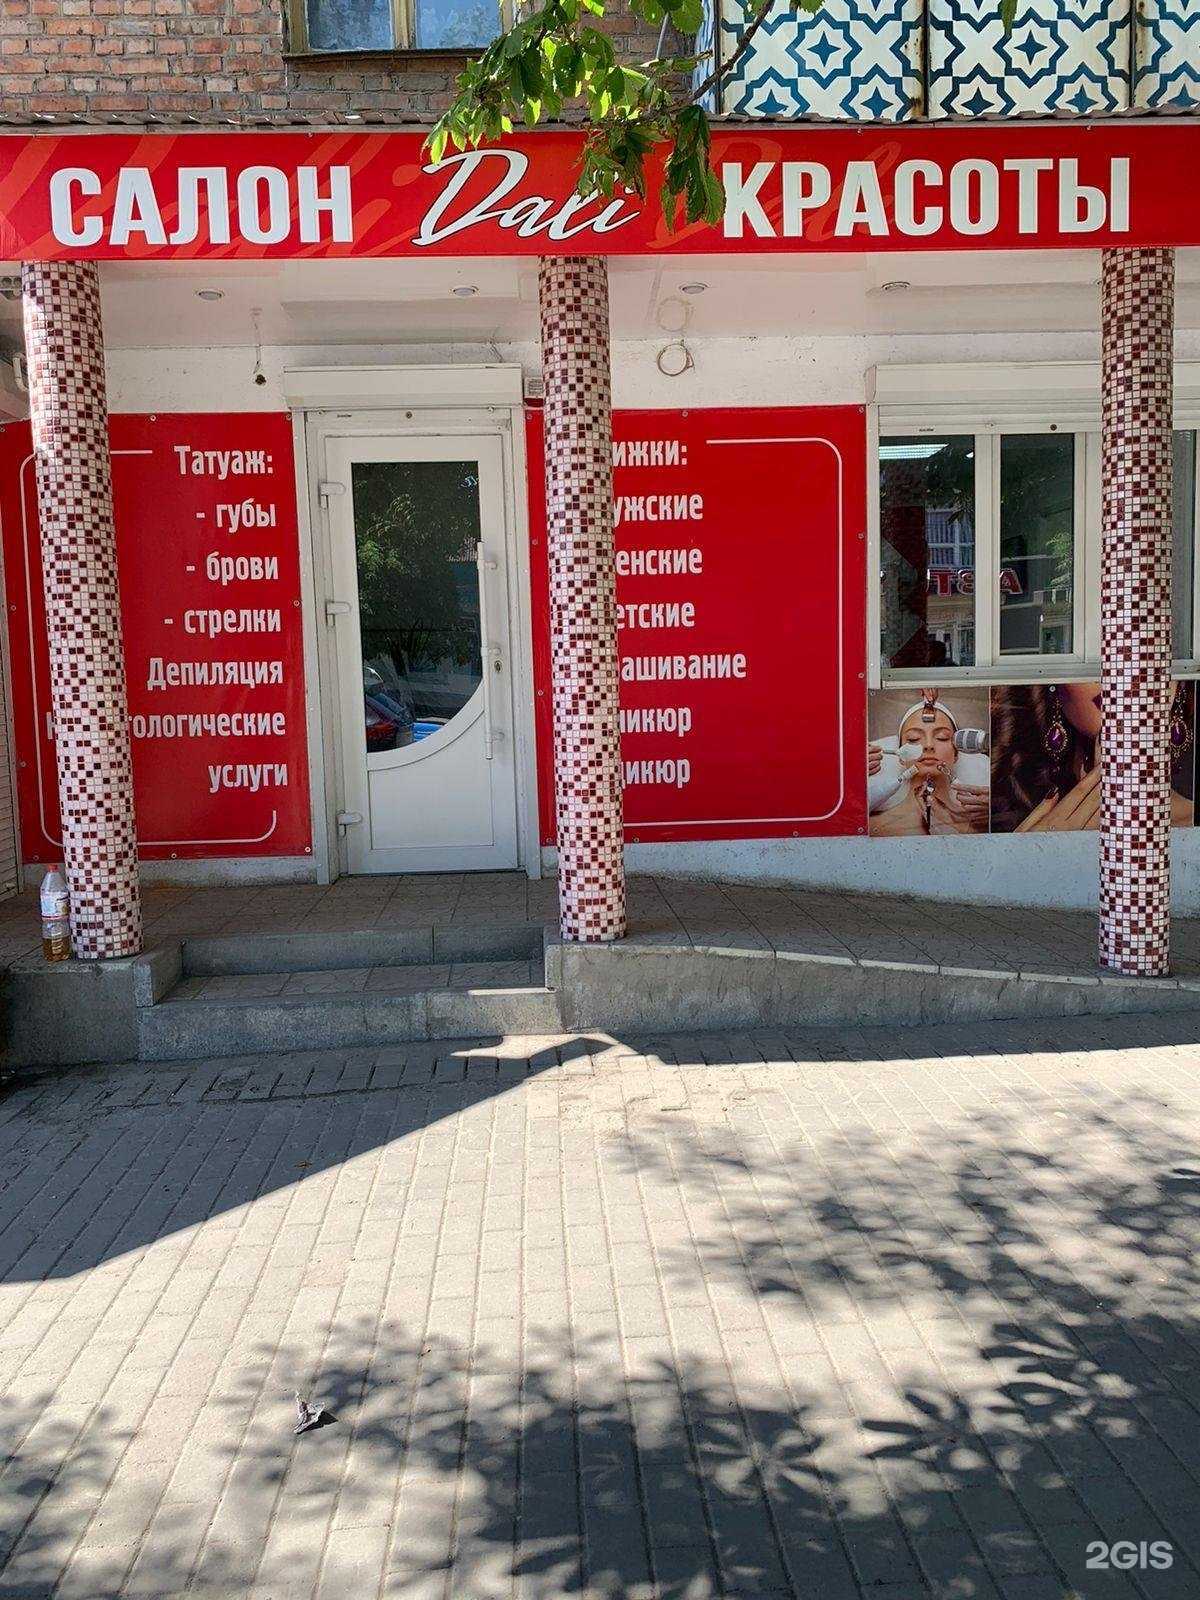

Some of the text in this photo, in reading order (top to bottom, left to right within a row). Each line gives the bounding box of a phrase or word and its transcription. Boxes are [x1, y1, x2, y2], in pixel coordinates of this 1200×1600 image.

[49, 165, 353, 248] САЛОН
[722, 158, 1131, 239] КРАСОТЫ
[174, 445, 273, 480] Татуаж:
[612, 440, 688, 467] ижки:
[216, 498, 276, 533] губы
[613, 494, 704, 528] ужские
[206, 551, 278, 586] брови
[616, 548, 703, 576] енские
[184, 609, 281, 638] стрелки
[616, 601, 696, 630] етские
[147, 657, 284, 690] Депиляция
[621, 653, 747, 682] ашивание
[46, 711, 286, 740] ологические
[208, 763, 289, 793] услуги
[621, 759, 691, 788] икюр
